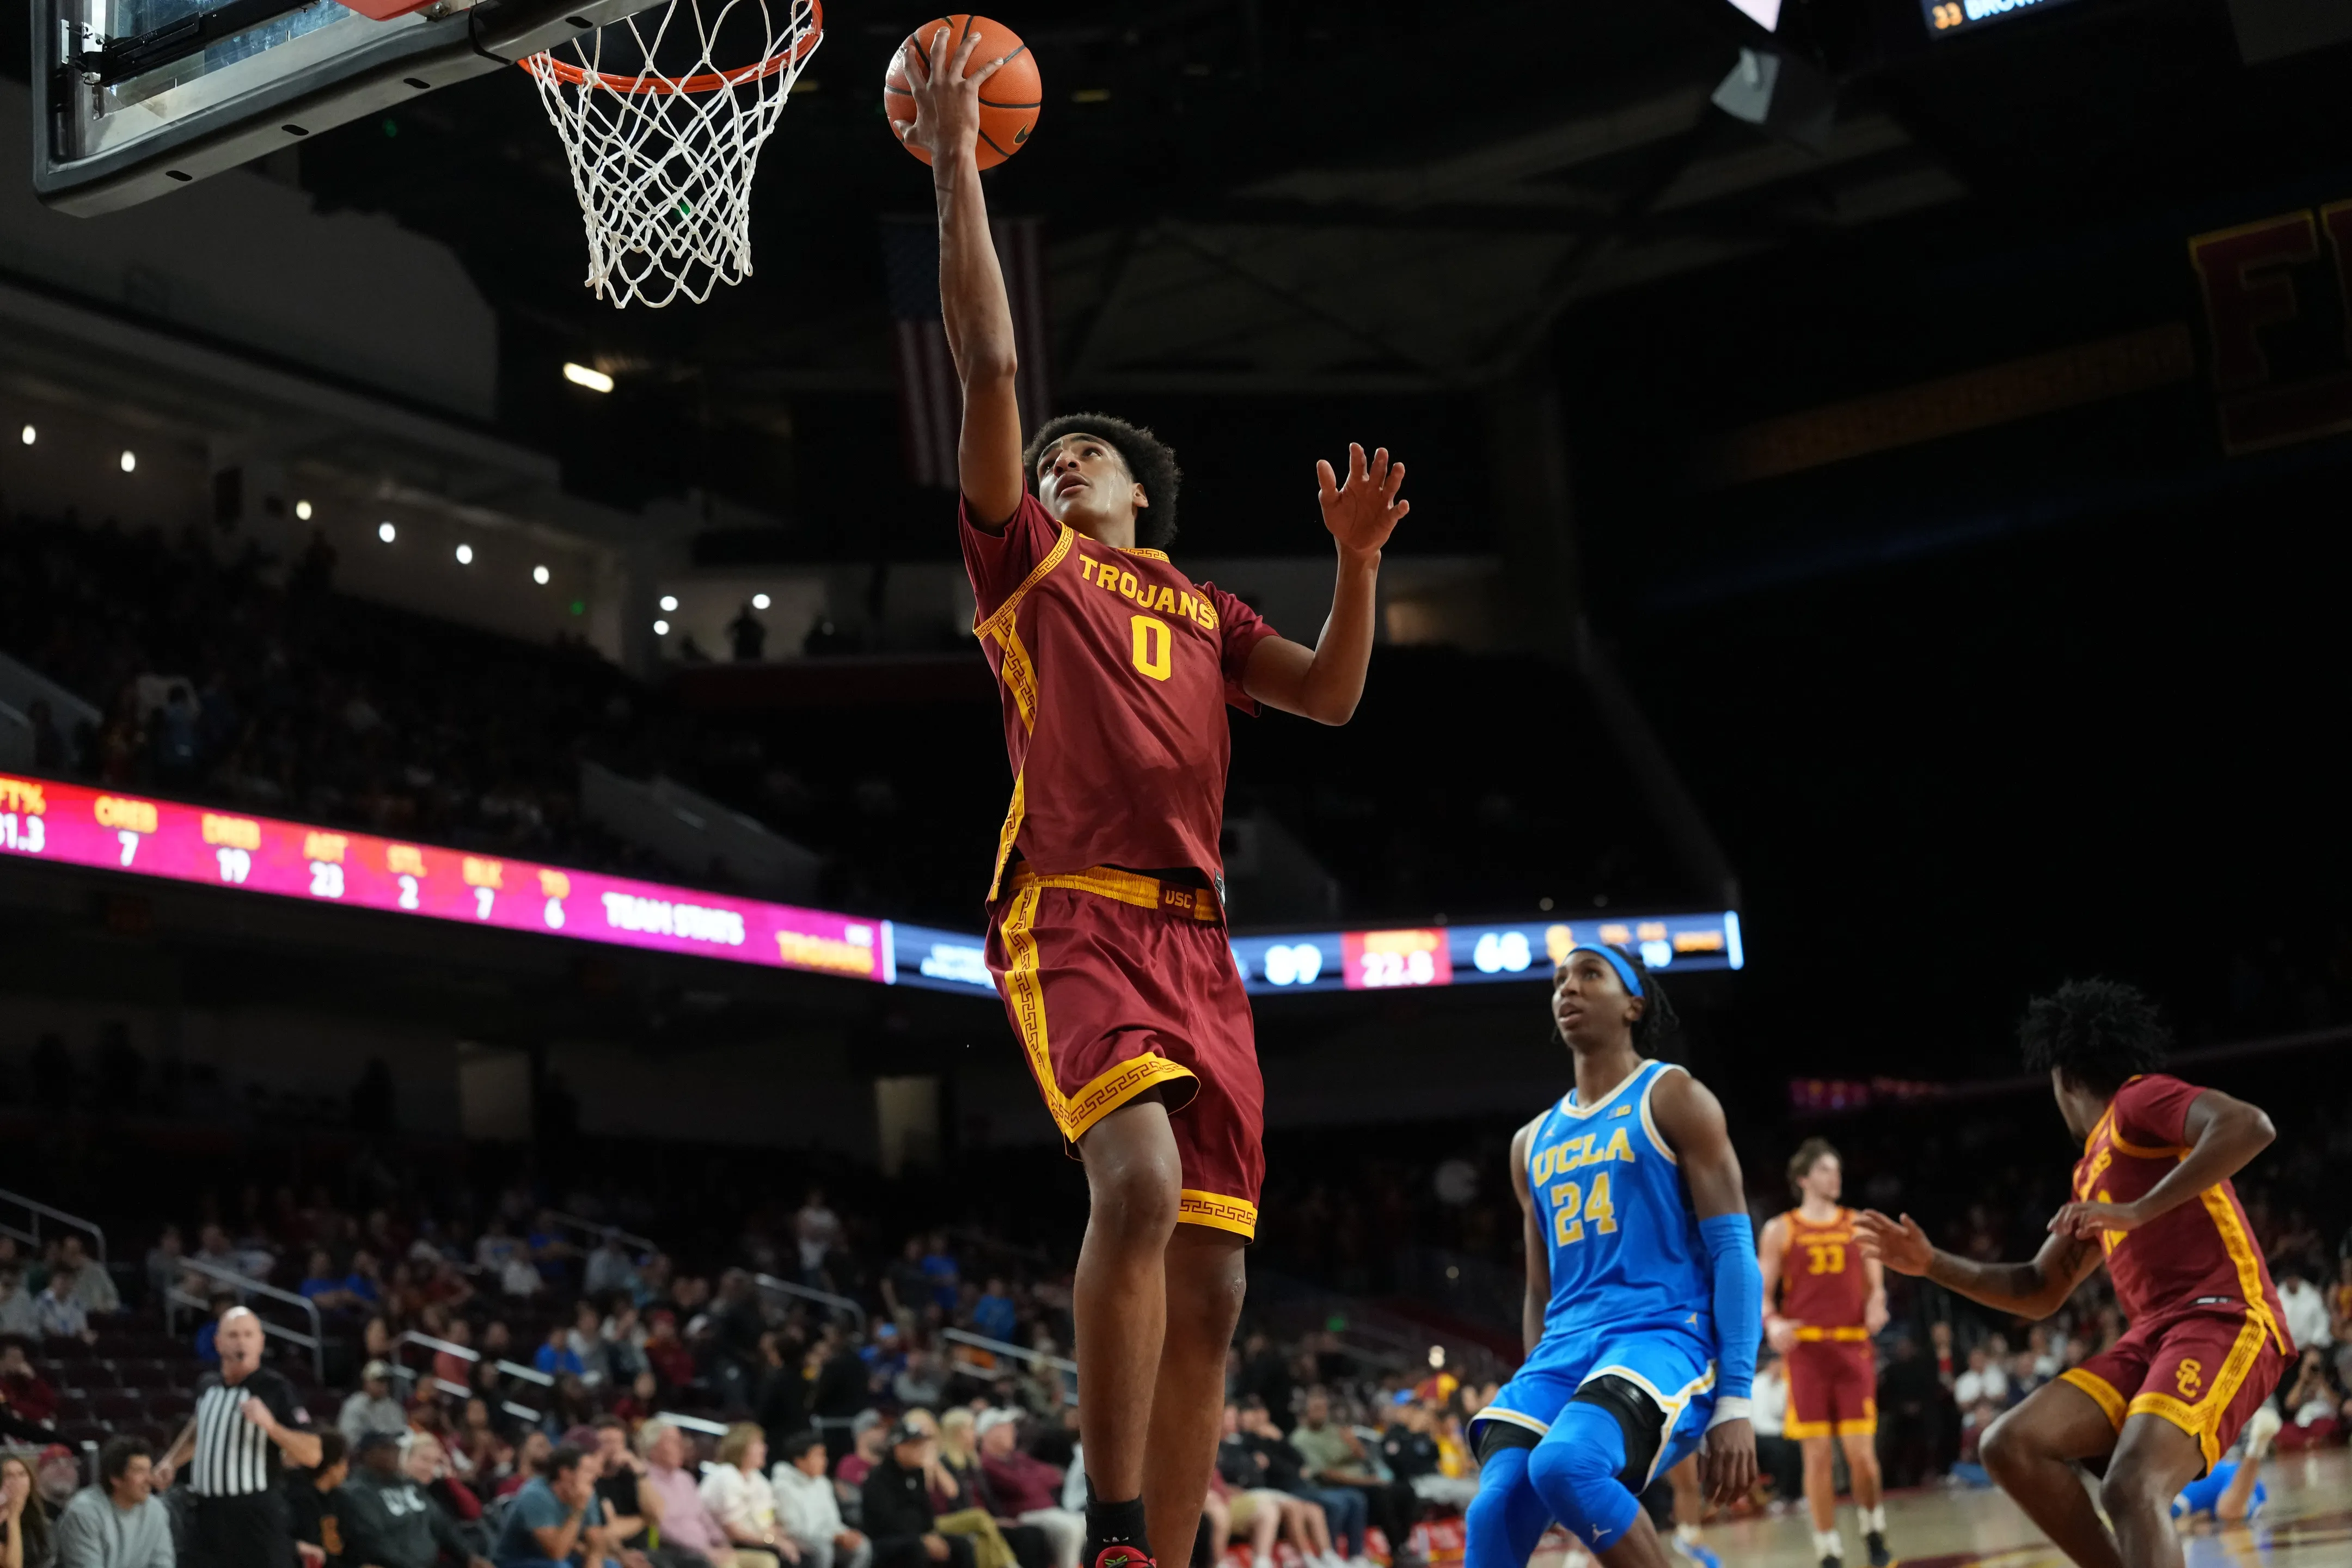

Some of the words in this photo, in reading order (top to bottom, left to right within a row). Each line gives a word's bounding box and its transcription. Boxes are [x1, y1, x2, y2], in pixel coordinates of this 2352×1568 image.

[1079, 553, 1215, 630] TROJANS
[1130, 615, 1172, 682] 0
[118, 830, 139, 866] 7
[398, 874, 419, 910] 2
[544, 896, 565, 929] 6
[1165, 890, 1192, 909] USC
[1532, 1126, 1635, 1188] UCLA
[1551, 1171, 1618, 1247] 24
